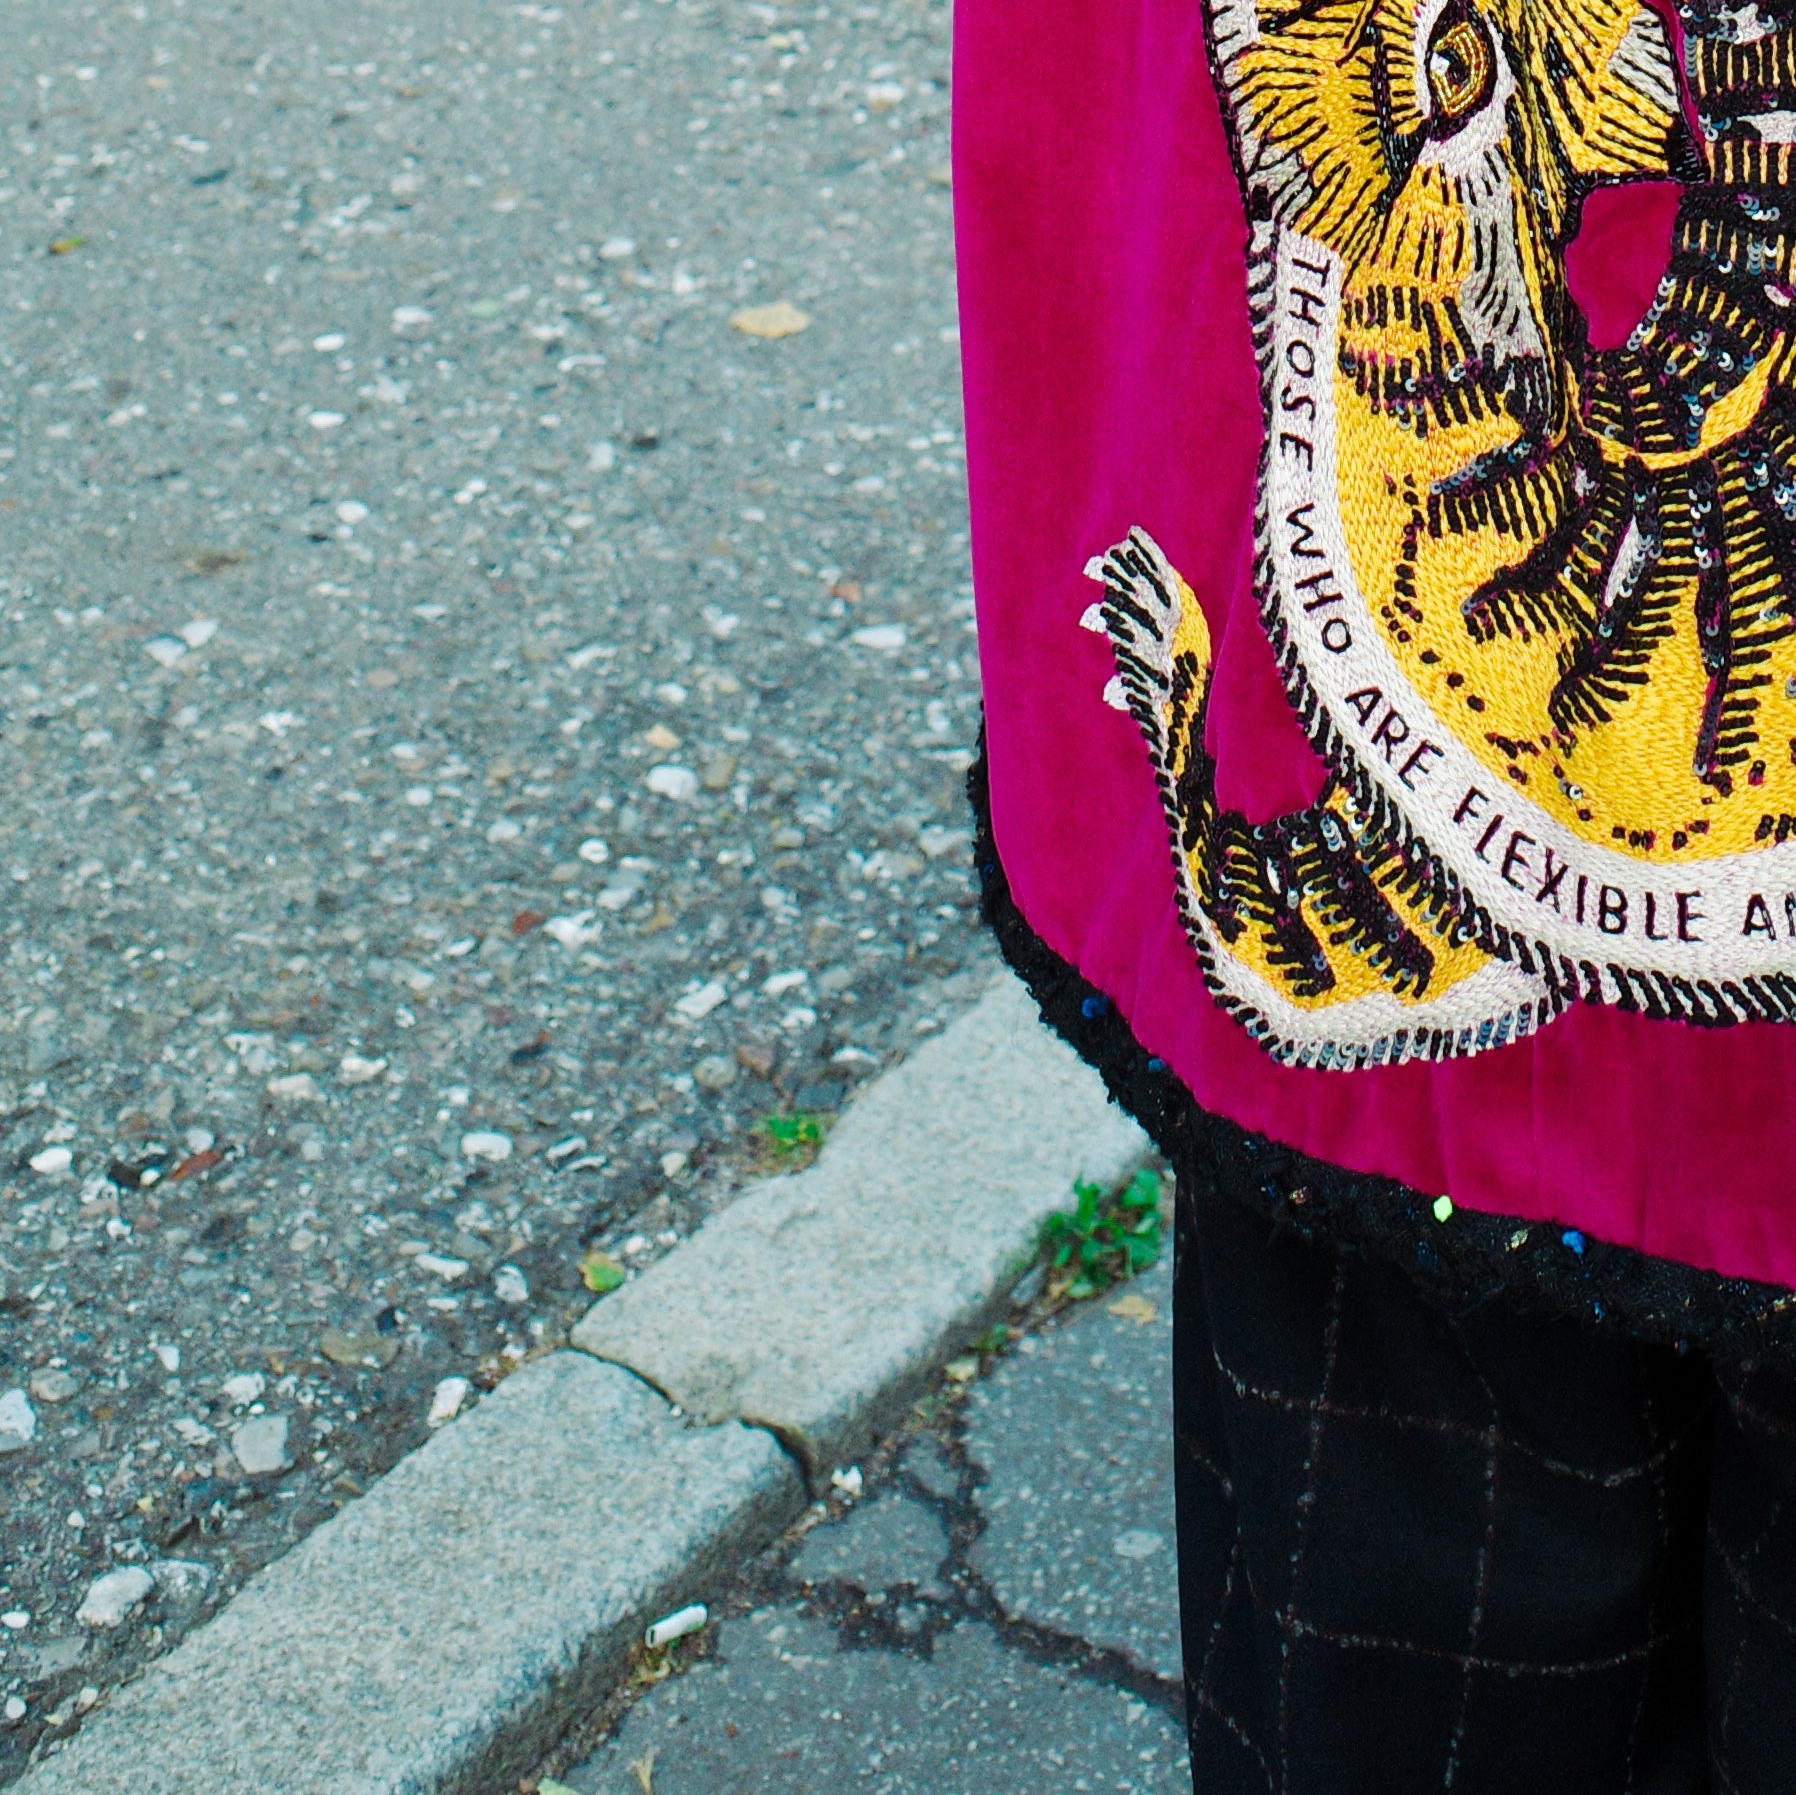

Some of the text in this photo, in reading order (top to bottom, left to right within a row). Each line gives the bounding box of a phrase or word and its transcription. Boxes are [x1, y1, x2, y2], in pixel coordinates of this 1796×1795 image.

[1278, 256, 1332, 474] THOSE
[1285, 501, 1353, 655] WHO
[1344, 685, 1446, 791] ARE
[1450, 785, 1703, 942] FLEXIBLE
